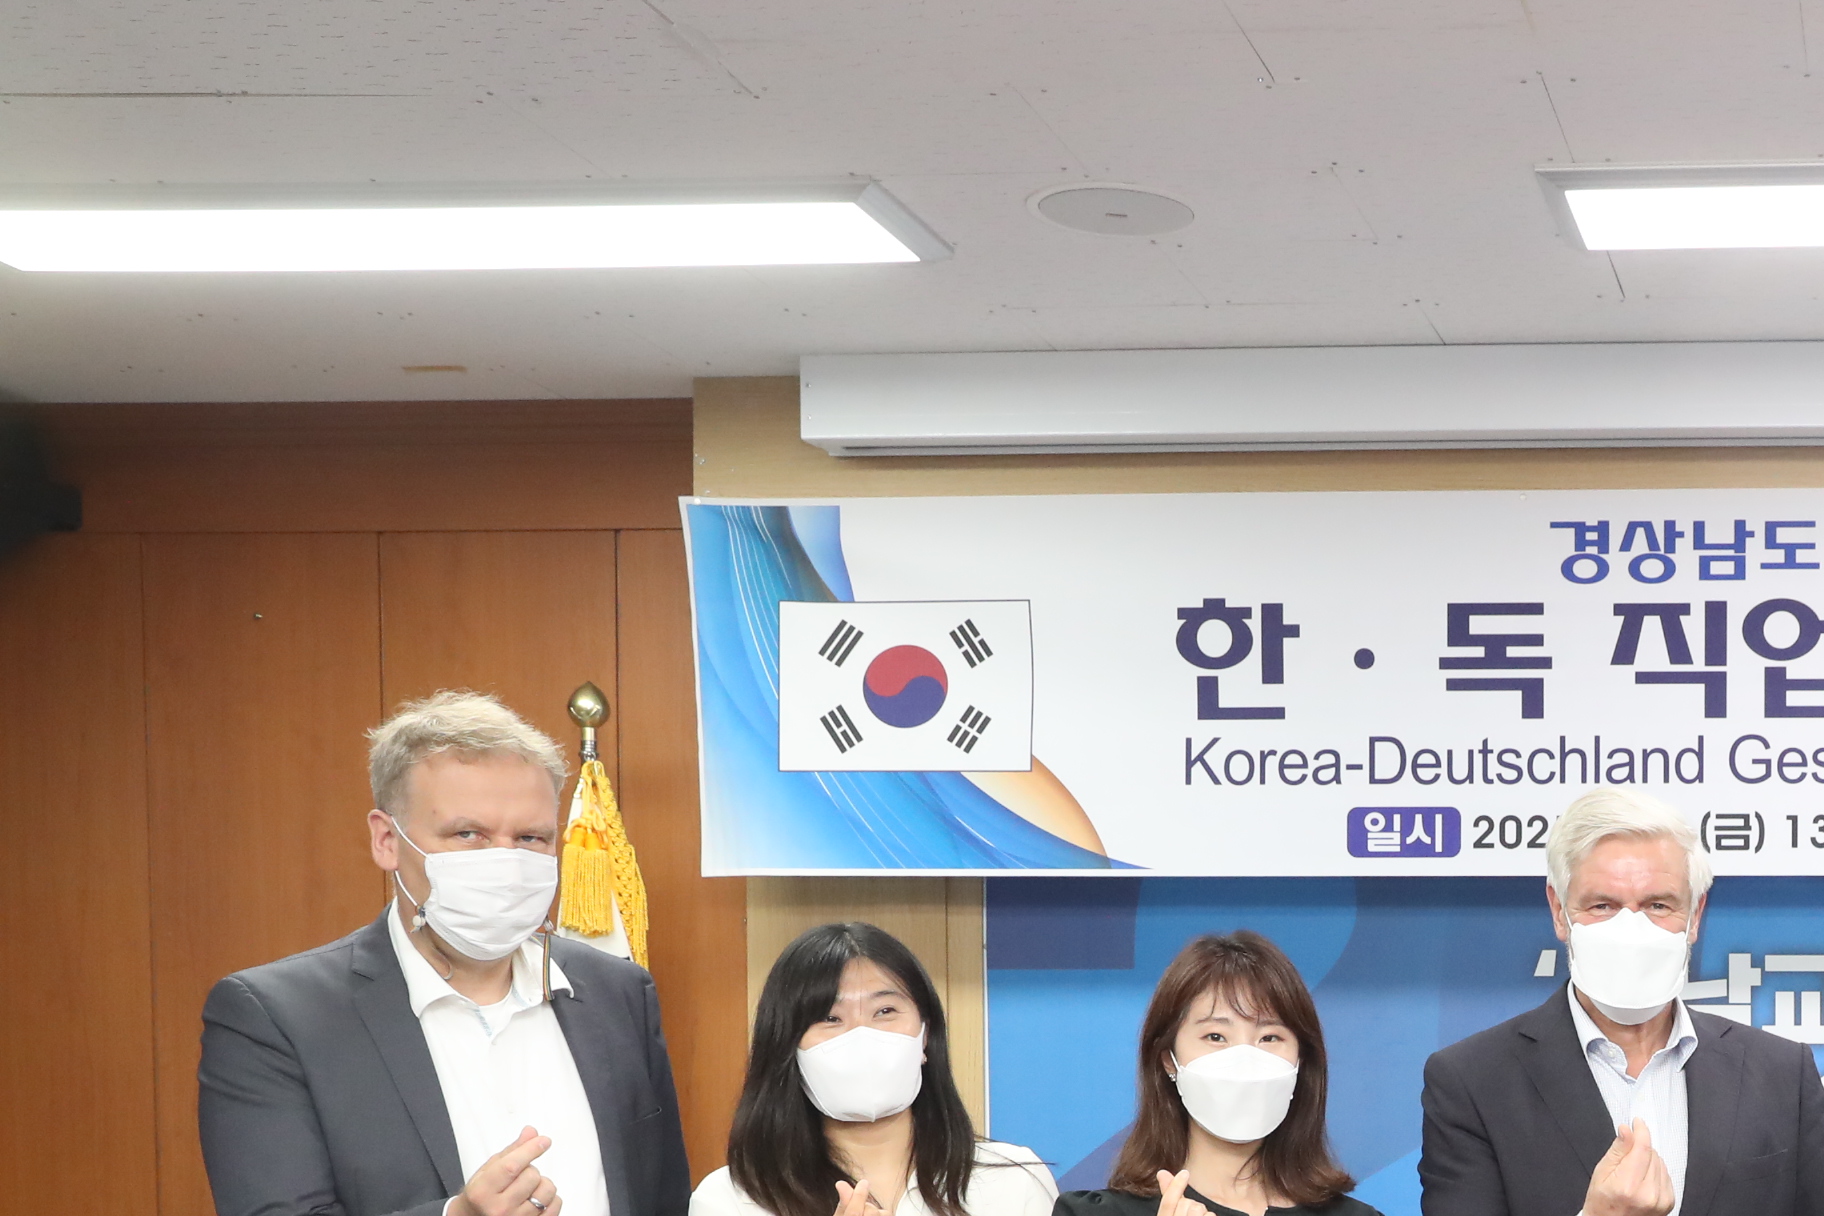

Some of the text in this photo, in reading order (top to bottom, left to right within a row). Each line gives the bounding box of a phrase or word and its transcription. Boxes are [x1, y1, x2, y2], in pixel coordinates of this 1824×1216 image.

[1175, 597, 1301, 721] 한
[1438, 602, 1553, 720] 독
[1185, 734, 1705, 786] Korea-Deutschland
[1363, 811, 1443, 853] 일시
[1472, 814, 1560, 850] 202
[1700, 810, 1765, 854] (금)
